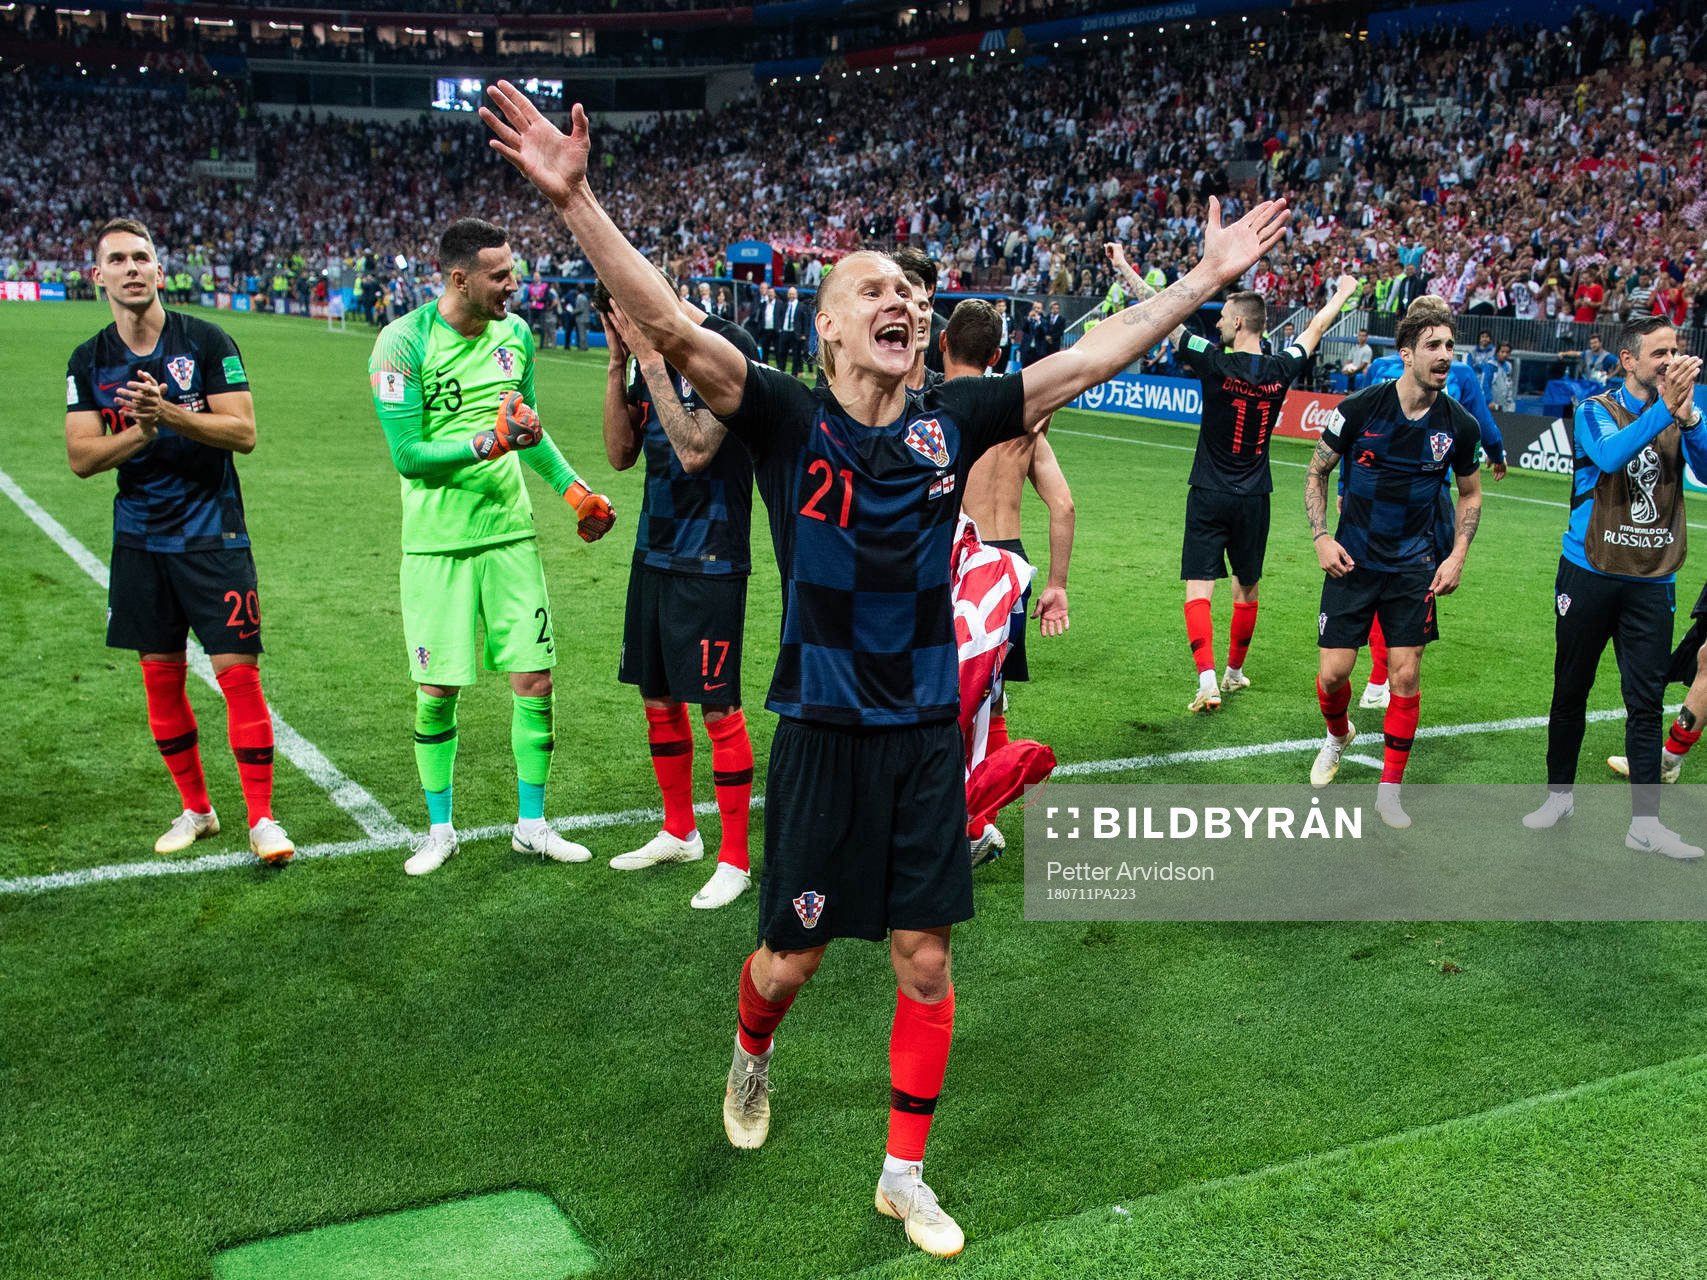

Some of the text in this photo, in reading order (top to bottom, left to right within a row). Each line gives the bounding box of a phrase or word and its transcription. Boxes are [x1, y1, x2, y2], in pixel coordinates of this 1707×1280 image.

[424, 378, 463, 412] 23
[1231, 398, 1271, 455] 11
[800, 459, 854, 528] 21
[1603, 529, 1652, 548] RUSSIA
[1619, 524, 1634, 533] FIFA
[1634, 527, 1656, 535] WORLD
[223, 590, 261, 627] 20
[535, 607, 551, 644] 2
[700, 639, 730, 678] 17
